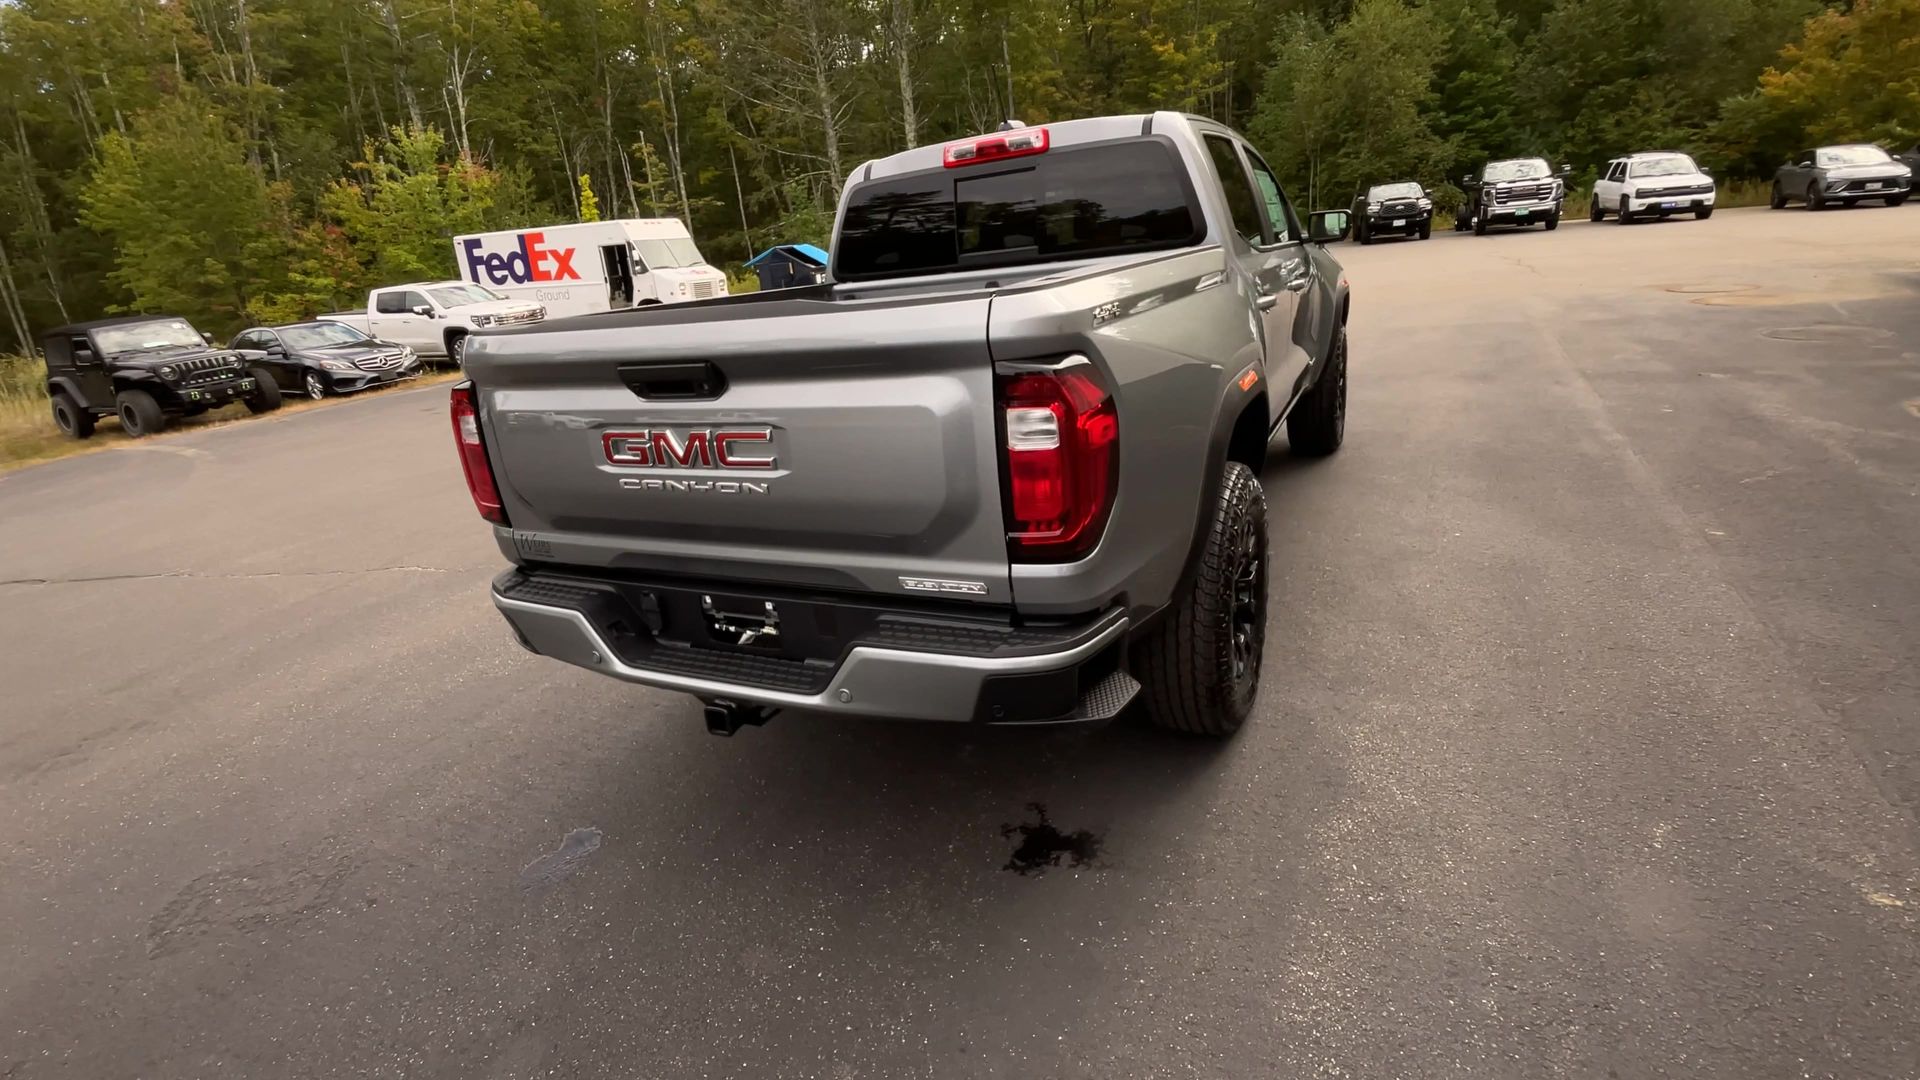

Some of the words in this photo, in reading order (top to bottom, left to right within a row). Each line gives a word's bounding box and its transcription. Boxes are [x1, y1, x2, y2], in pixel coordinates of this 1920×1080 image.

[463, 233, 582, 285] FedEx
[535, 288, 570, 302] Ground
[601, 429, 777, 470] GMC
[619, 478, 770, 495] CANYON
